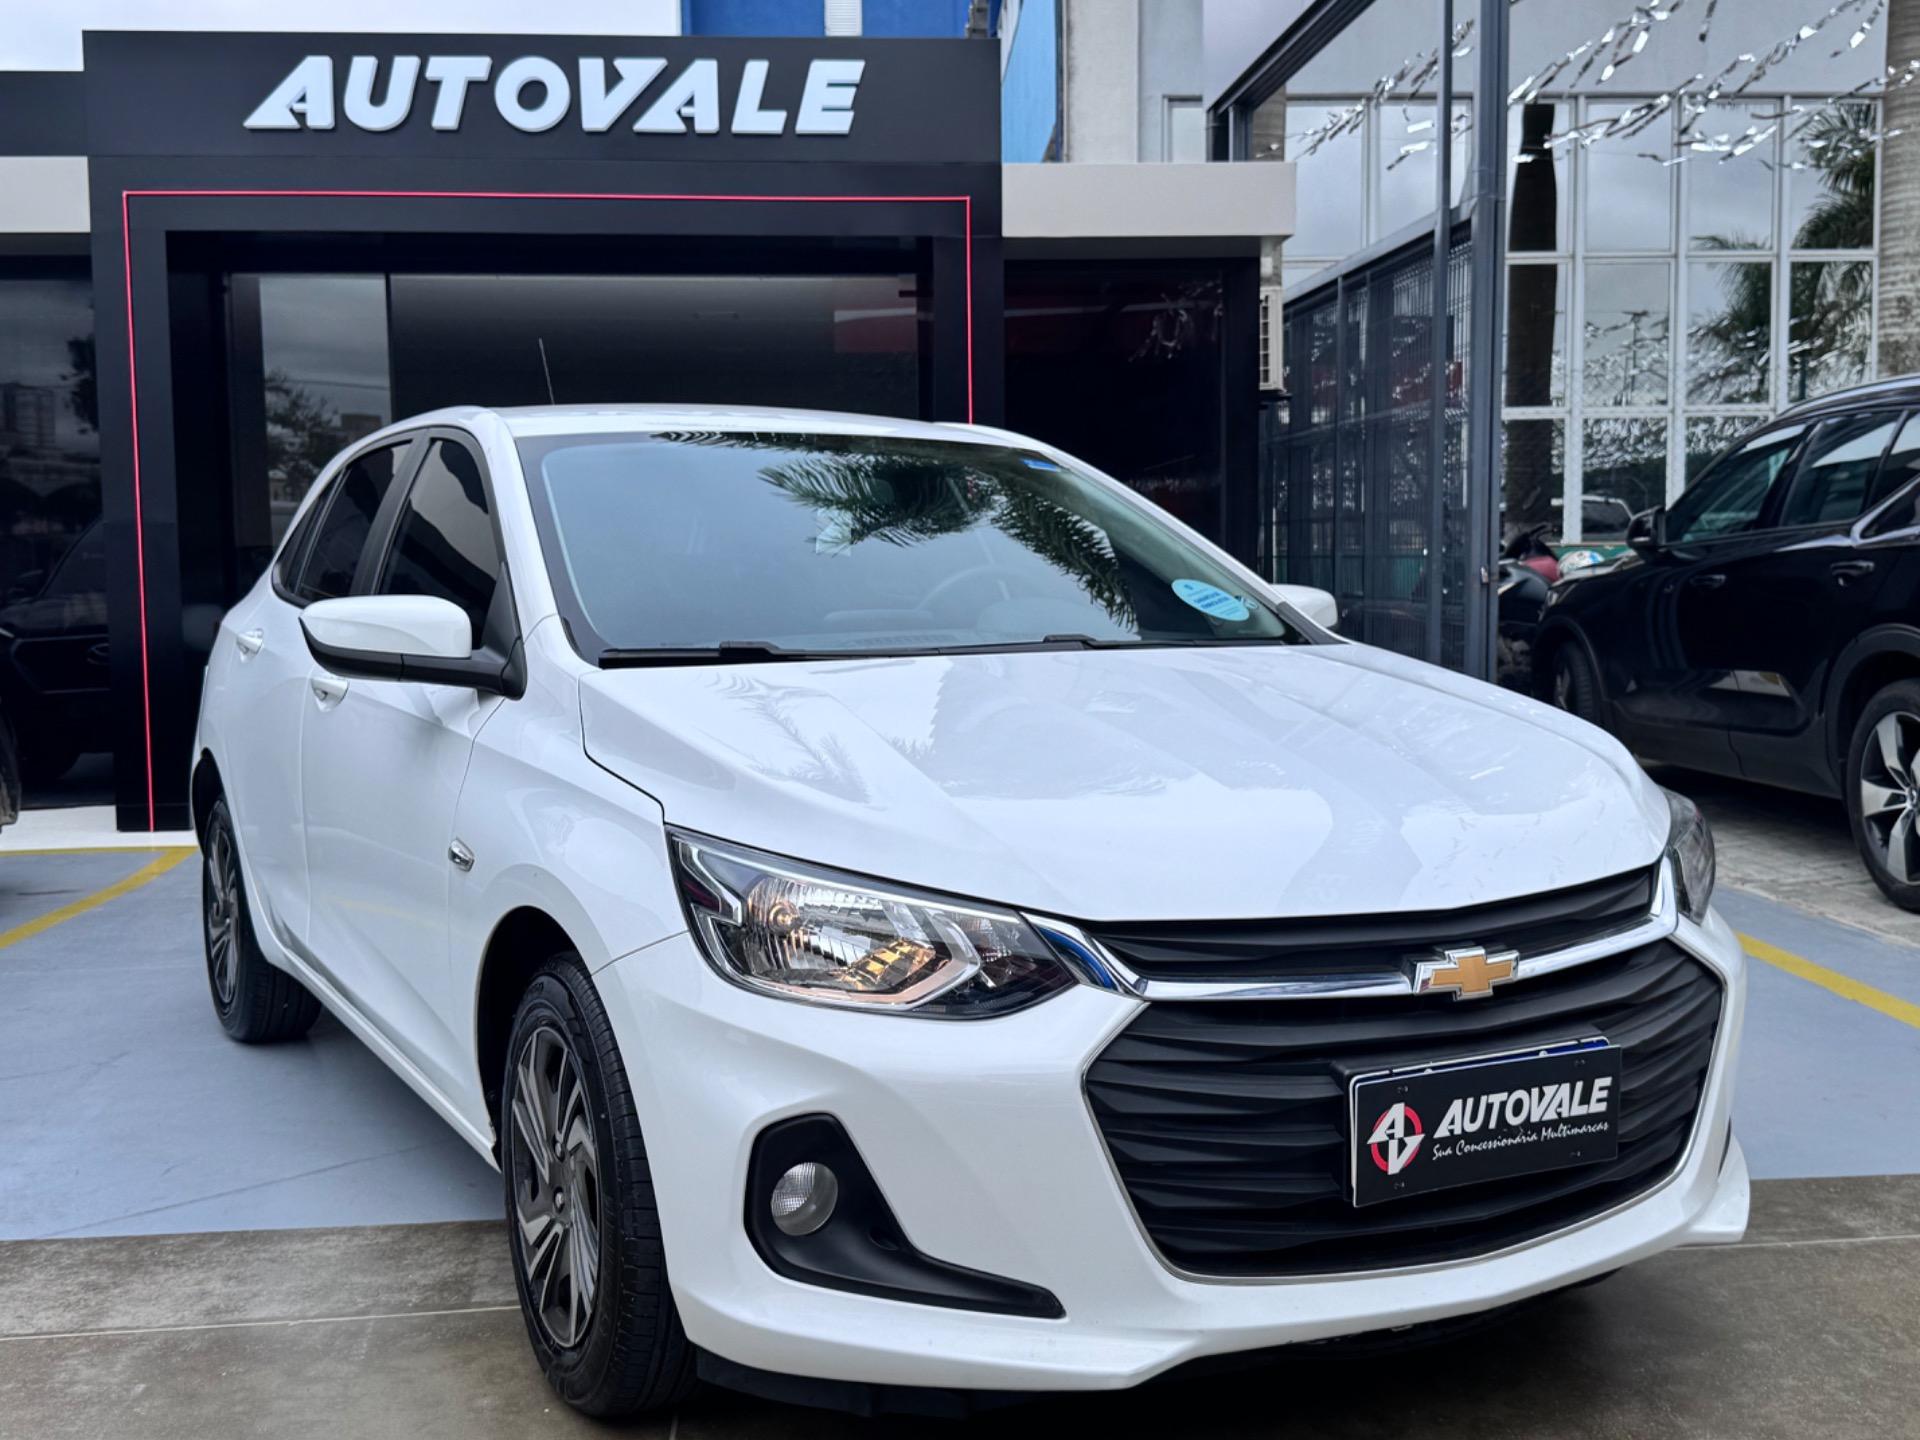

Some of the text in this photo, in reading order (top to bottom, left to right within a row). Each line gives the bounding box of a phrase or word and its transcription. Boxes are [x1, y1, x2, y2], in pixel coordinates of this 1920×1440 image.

[243, 55, 866, 134] AUTOVALE
[1433, 1077, 1612, 1138] AUTOVALE
[1432, 1144, 1452, 1160] Sua
[1541, 1122, 1609, 1142] Multimarcas
